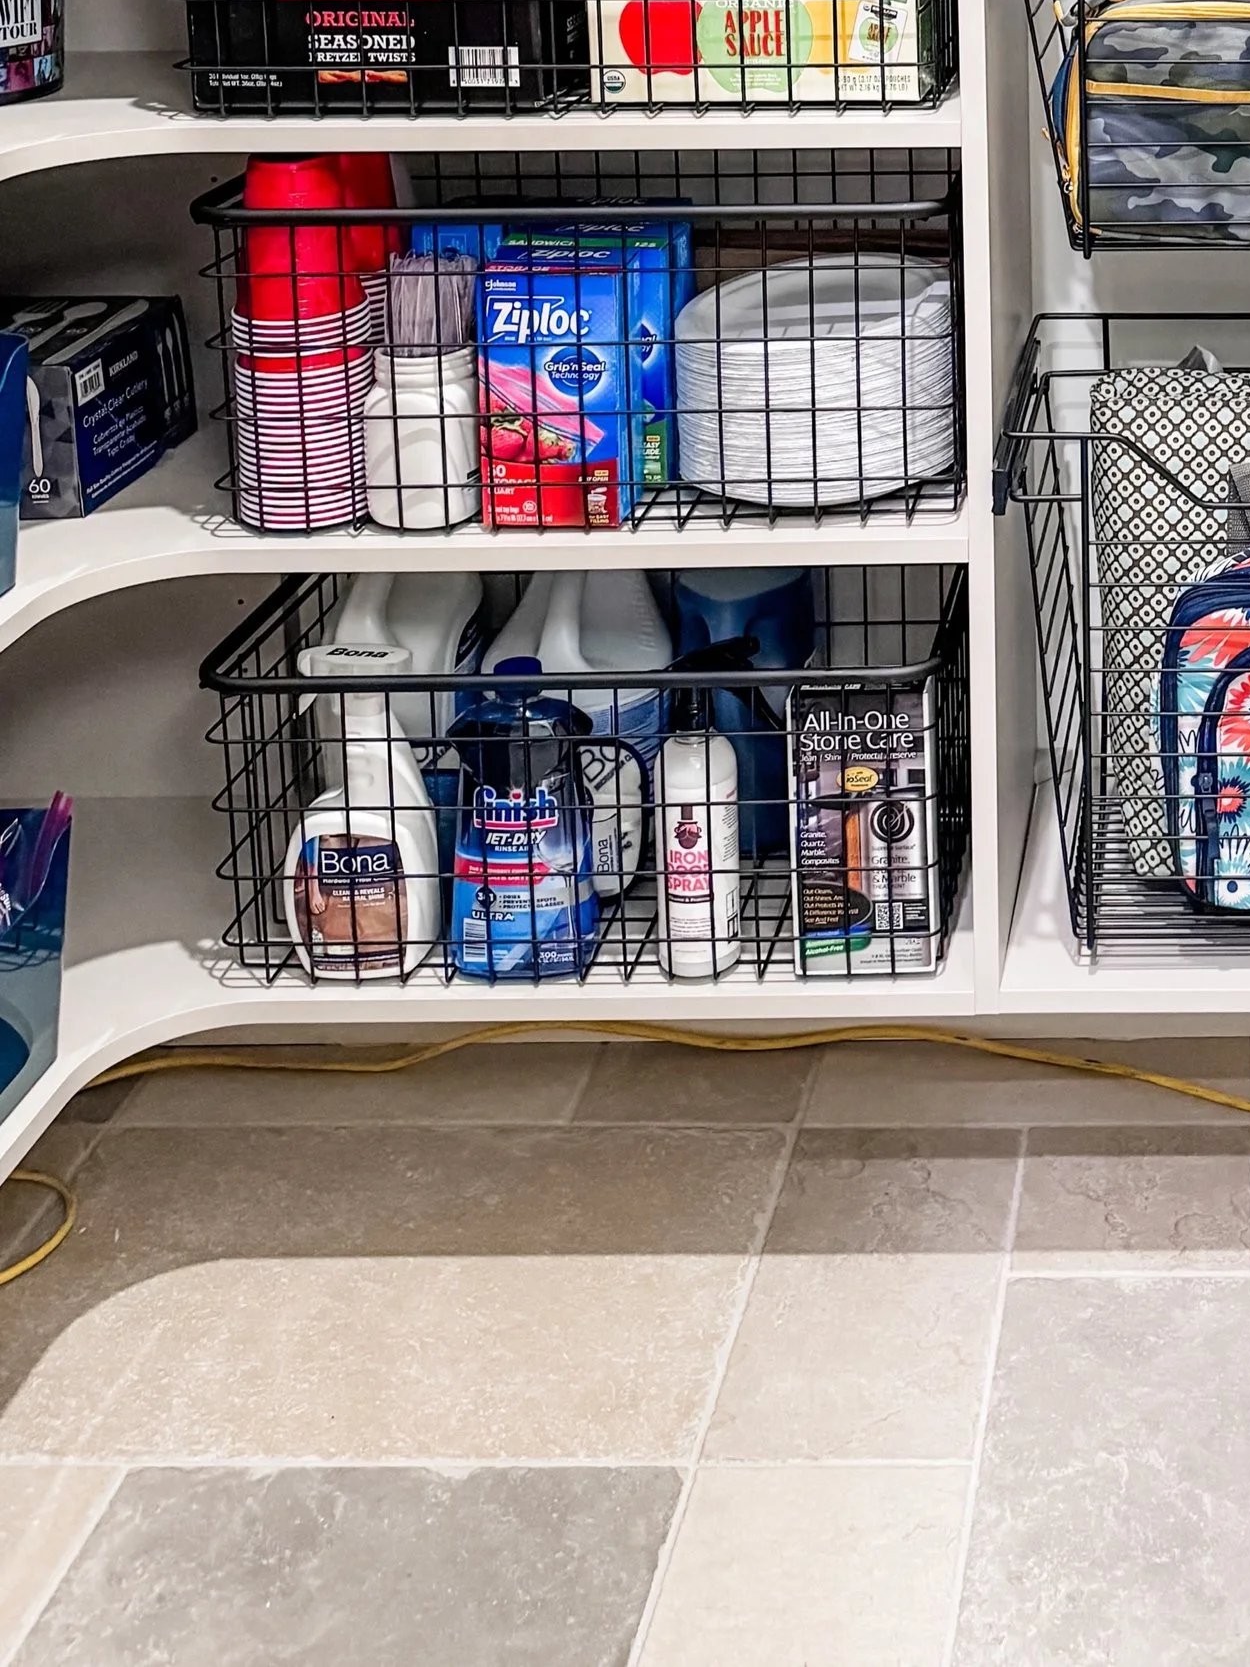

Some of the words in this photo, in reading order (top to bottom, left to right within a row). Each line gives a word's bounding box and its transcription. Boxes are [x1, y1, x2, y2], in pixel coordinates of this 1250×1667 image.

[305, 11, 415, 27] ORIGINAL
[725, 9, 784, 33] APPLE
[308, 34, 415, 49] SEASONED
[725, 33, 785, 57] SAUCE
[367, 52, 416, 62] TWISTS
[531, 249, 611, 259] Ziploc
[493, 301, 590, 344] Ziploc
[108, 350, 139, 377] KIRKLAND
[582, 361, 605, 371] Seal
[552, 372, 600, 380] Technoogy
[83, 404, 107, 428] Crystal
[29, 479, 51, 494] 60
[326, 648, 389, 658] Bona
[804, 710, 909, 731] All-In-One
[800, 732, 861, 751] Stone
[866, 732, 914, 749] Care
[800, 754, 817, 762] lean
[885, 751, 916, 759] reserve
[485, 830, 546, 845] JET-DRY
[321, 851, 391, 873] Bona
[597, 839, 610, 873] Bona
[670, 849, 708, 864] IRON
[801, 858, 840, 866] Composites
[472, 911, 514, 921] ULTRA
